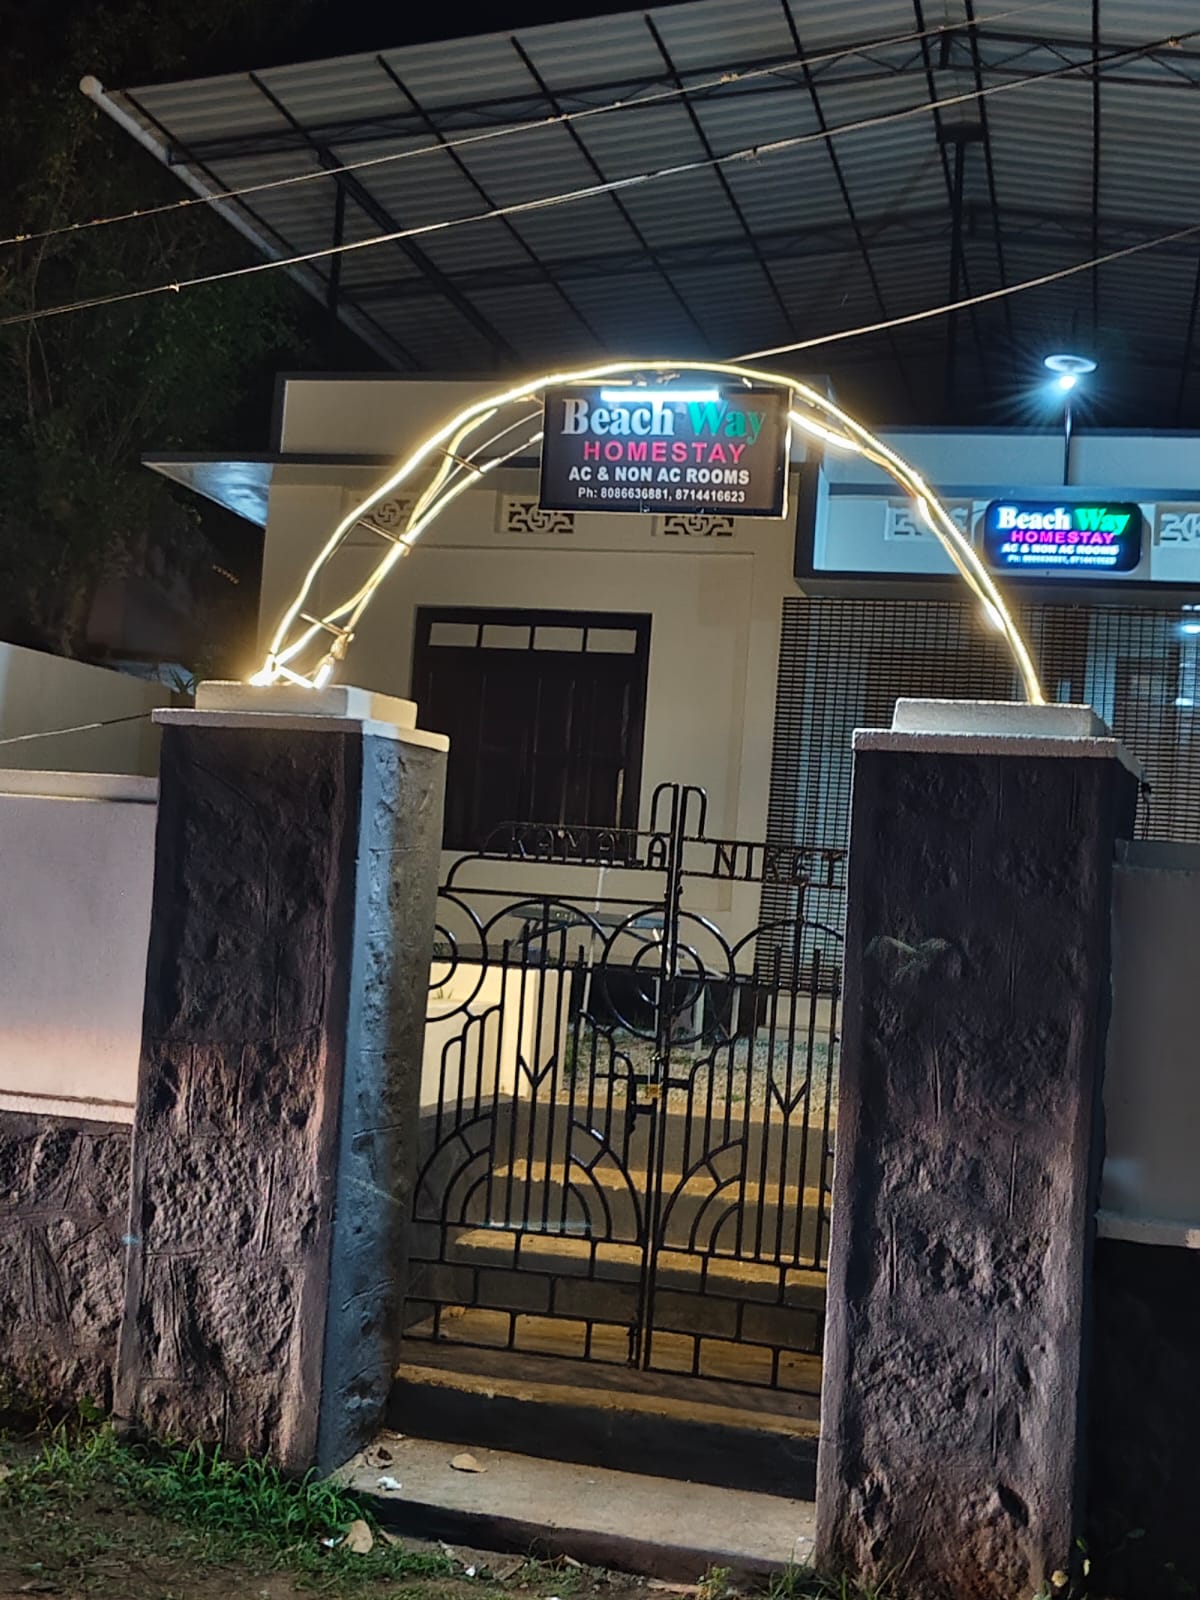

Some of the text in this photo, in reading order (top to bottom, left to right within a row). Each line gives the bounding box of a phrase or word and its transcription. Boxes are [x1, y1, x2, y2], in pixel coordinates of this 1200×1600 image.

[560, 399, 766, 444] Beach Way
[583, 441, 746, 464] HOMESTAY
[569, 467, 750, 485] AC & NON AC ROOMS
[577, 487, 598, 499] Ph:
[997, 506, 1130, 535] Beach Way
[1011, 531, 1115, 544] HOMESTAY
